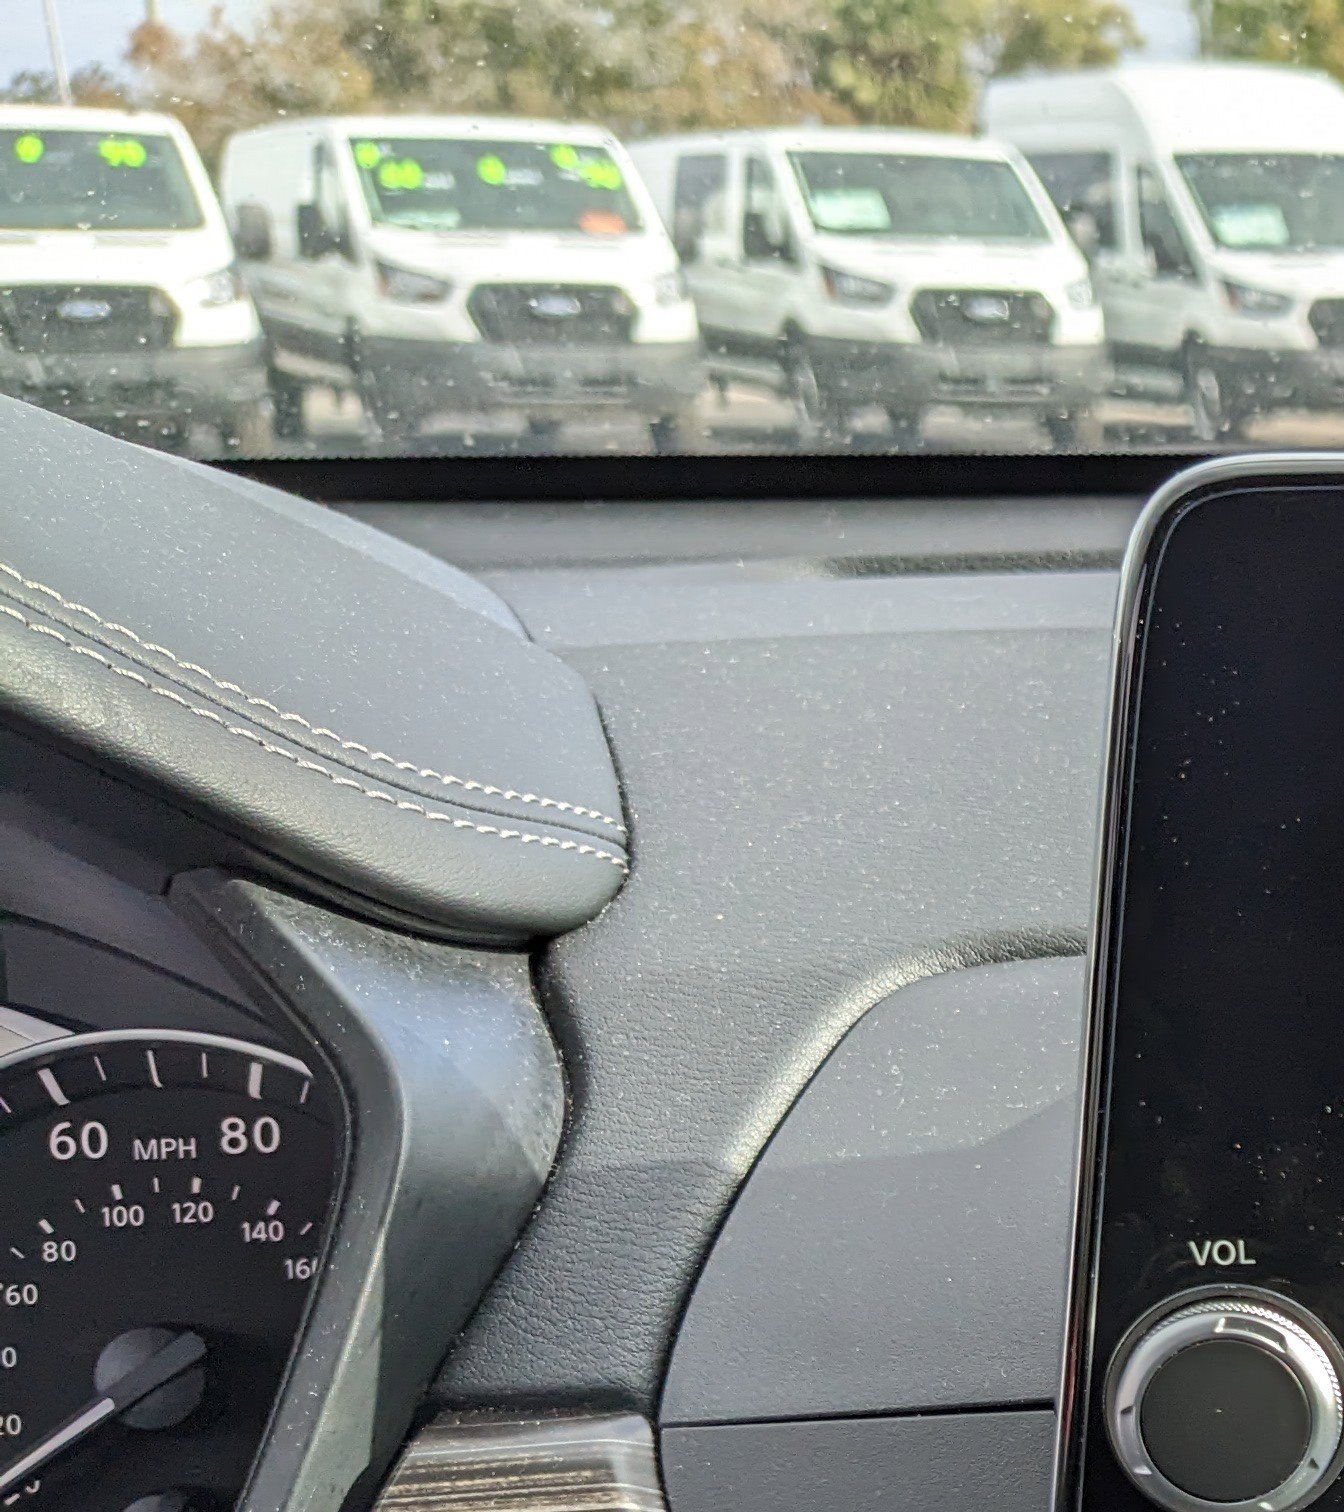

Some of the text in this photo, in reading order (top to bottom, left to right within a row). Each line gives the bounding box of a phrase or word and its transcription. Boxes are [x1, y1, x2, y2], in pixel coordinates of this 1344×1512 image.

[50, 1121, 108, 1161] 60
[220, 1116, 281, 1155] 80
[132, 1137, 198, 1160] MPH
[101, 1205, 145, 1228] 100
[172, 1201, 214, 1224] 120
[241, 1220, 285, 1243] 140
[42, 1240, 77, 1263] 80
[1188, 1240, 1256, 1266] VOL
[5, 1283, 39, 1306] 60
[0, 1347, 17, 1368] 0
[0, 1414, 22, 1436] 0
